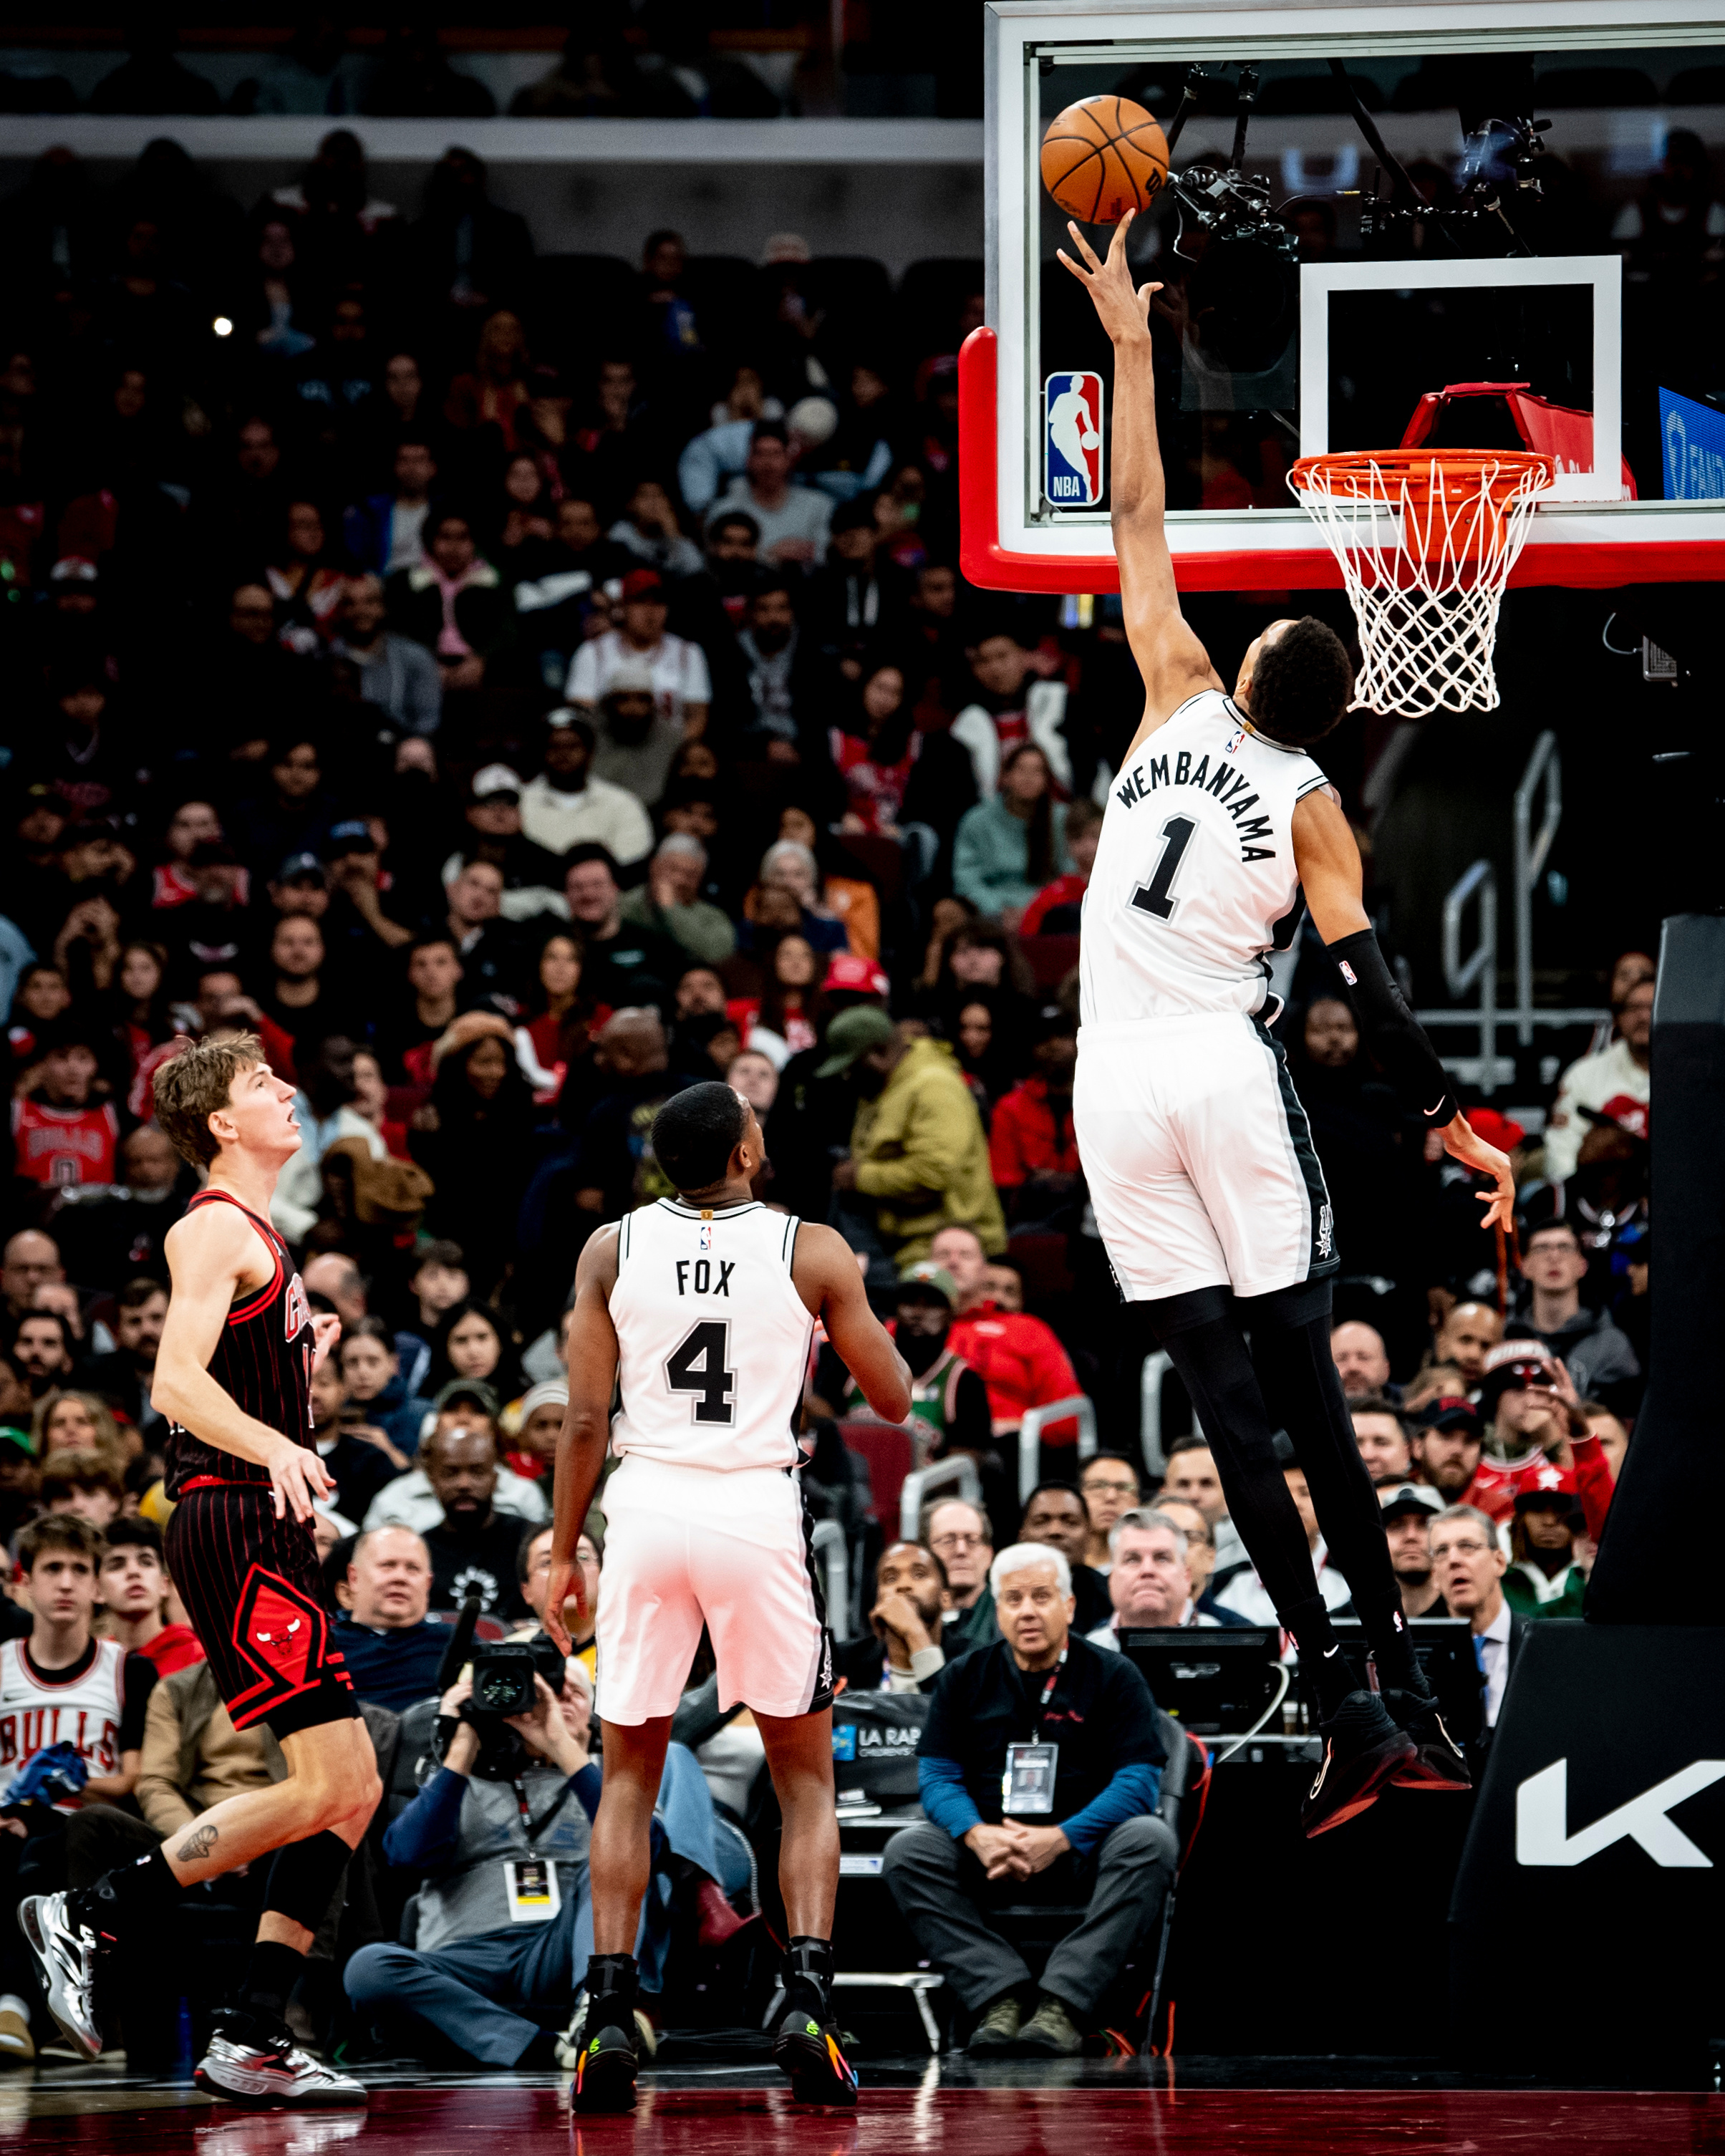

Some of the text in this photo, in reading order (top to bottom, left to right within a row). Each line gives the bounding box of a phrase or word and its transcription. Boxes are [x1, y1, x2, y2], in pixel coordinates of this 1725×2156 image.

[1053, 476, 1081, 497] NBA
[1116, 751, 1277, 863] WEMBANYAMA
[1126, 811, 1202, 926] 1
[676, 1259, 736, 1297] FOX
[661, 1317, 738, 1429] 4
[859, 1726, 883, 1746] LA
